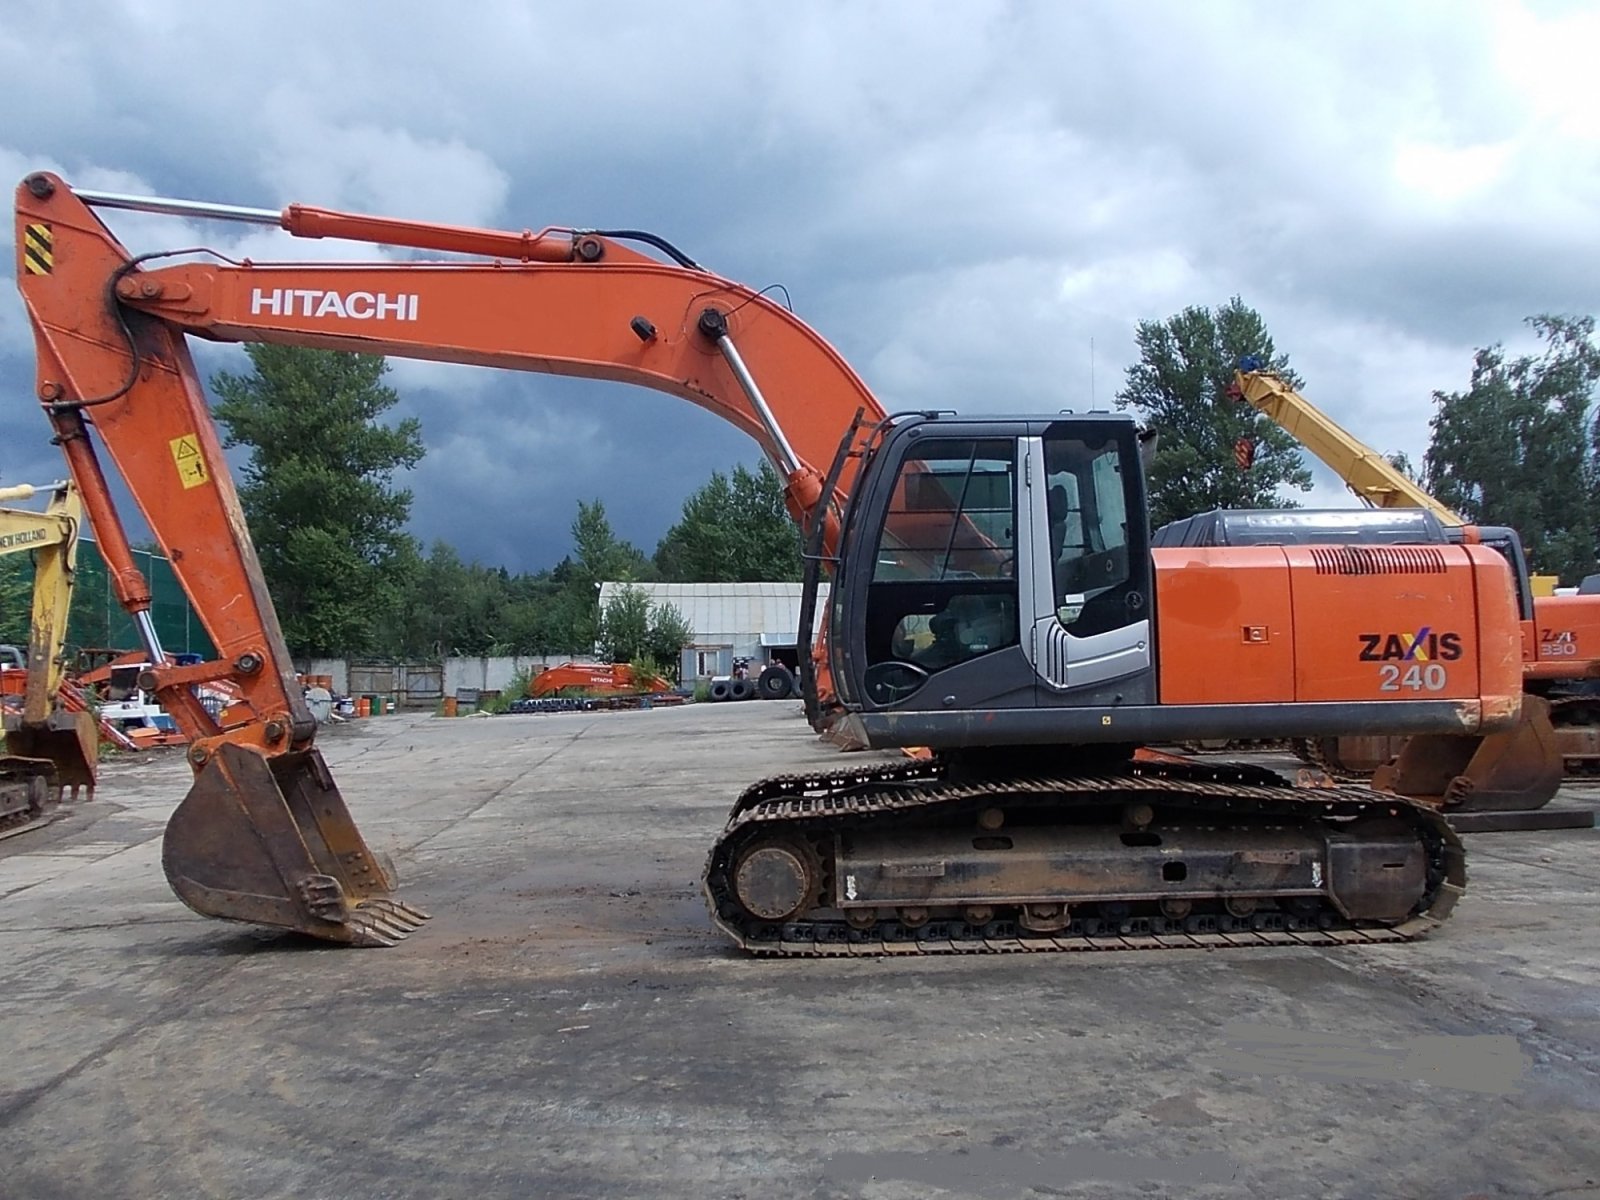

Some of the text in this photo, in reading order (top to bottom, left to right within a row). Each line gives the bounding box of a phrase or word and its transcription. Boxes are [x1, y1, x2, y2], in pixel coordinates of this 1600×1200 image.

[251, 288, 419, 321] HITACHI
[15, 528, 46, 545] HOLLAND
[1358, 627, 1462, 661] ZAXIS
[1541, 643, 1577, 656] 330
[1379, 663, 1447, 692] 240
